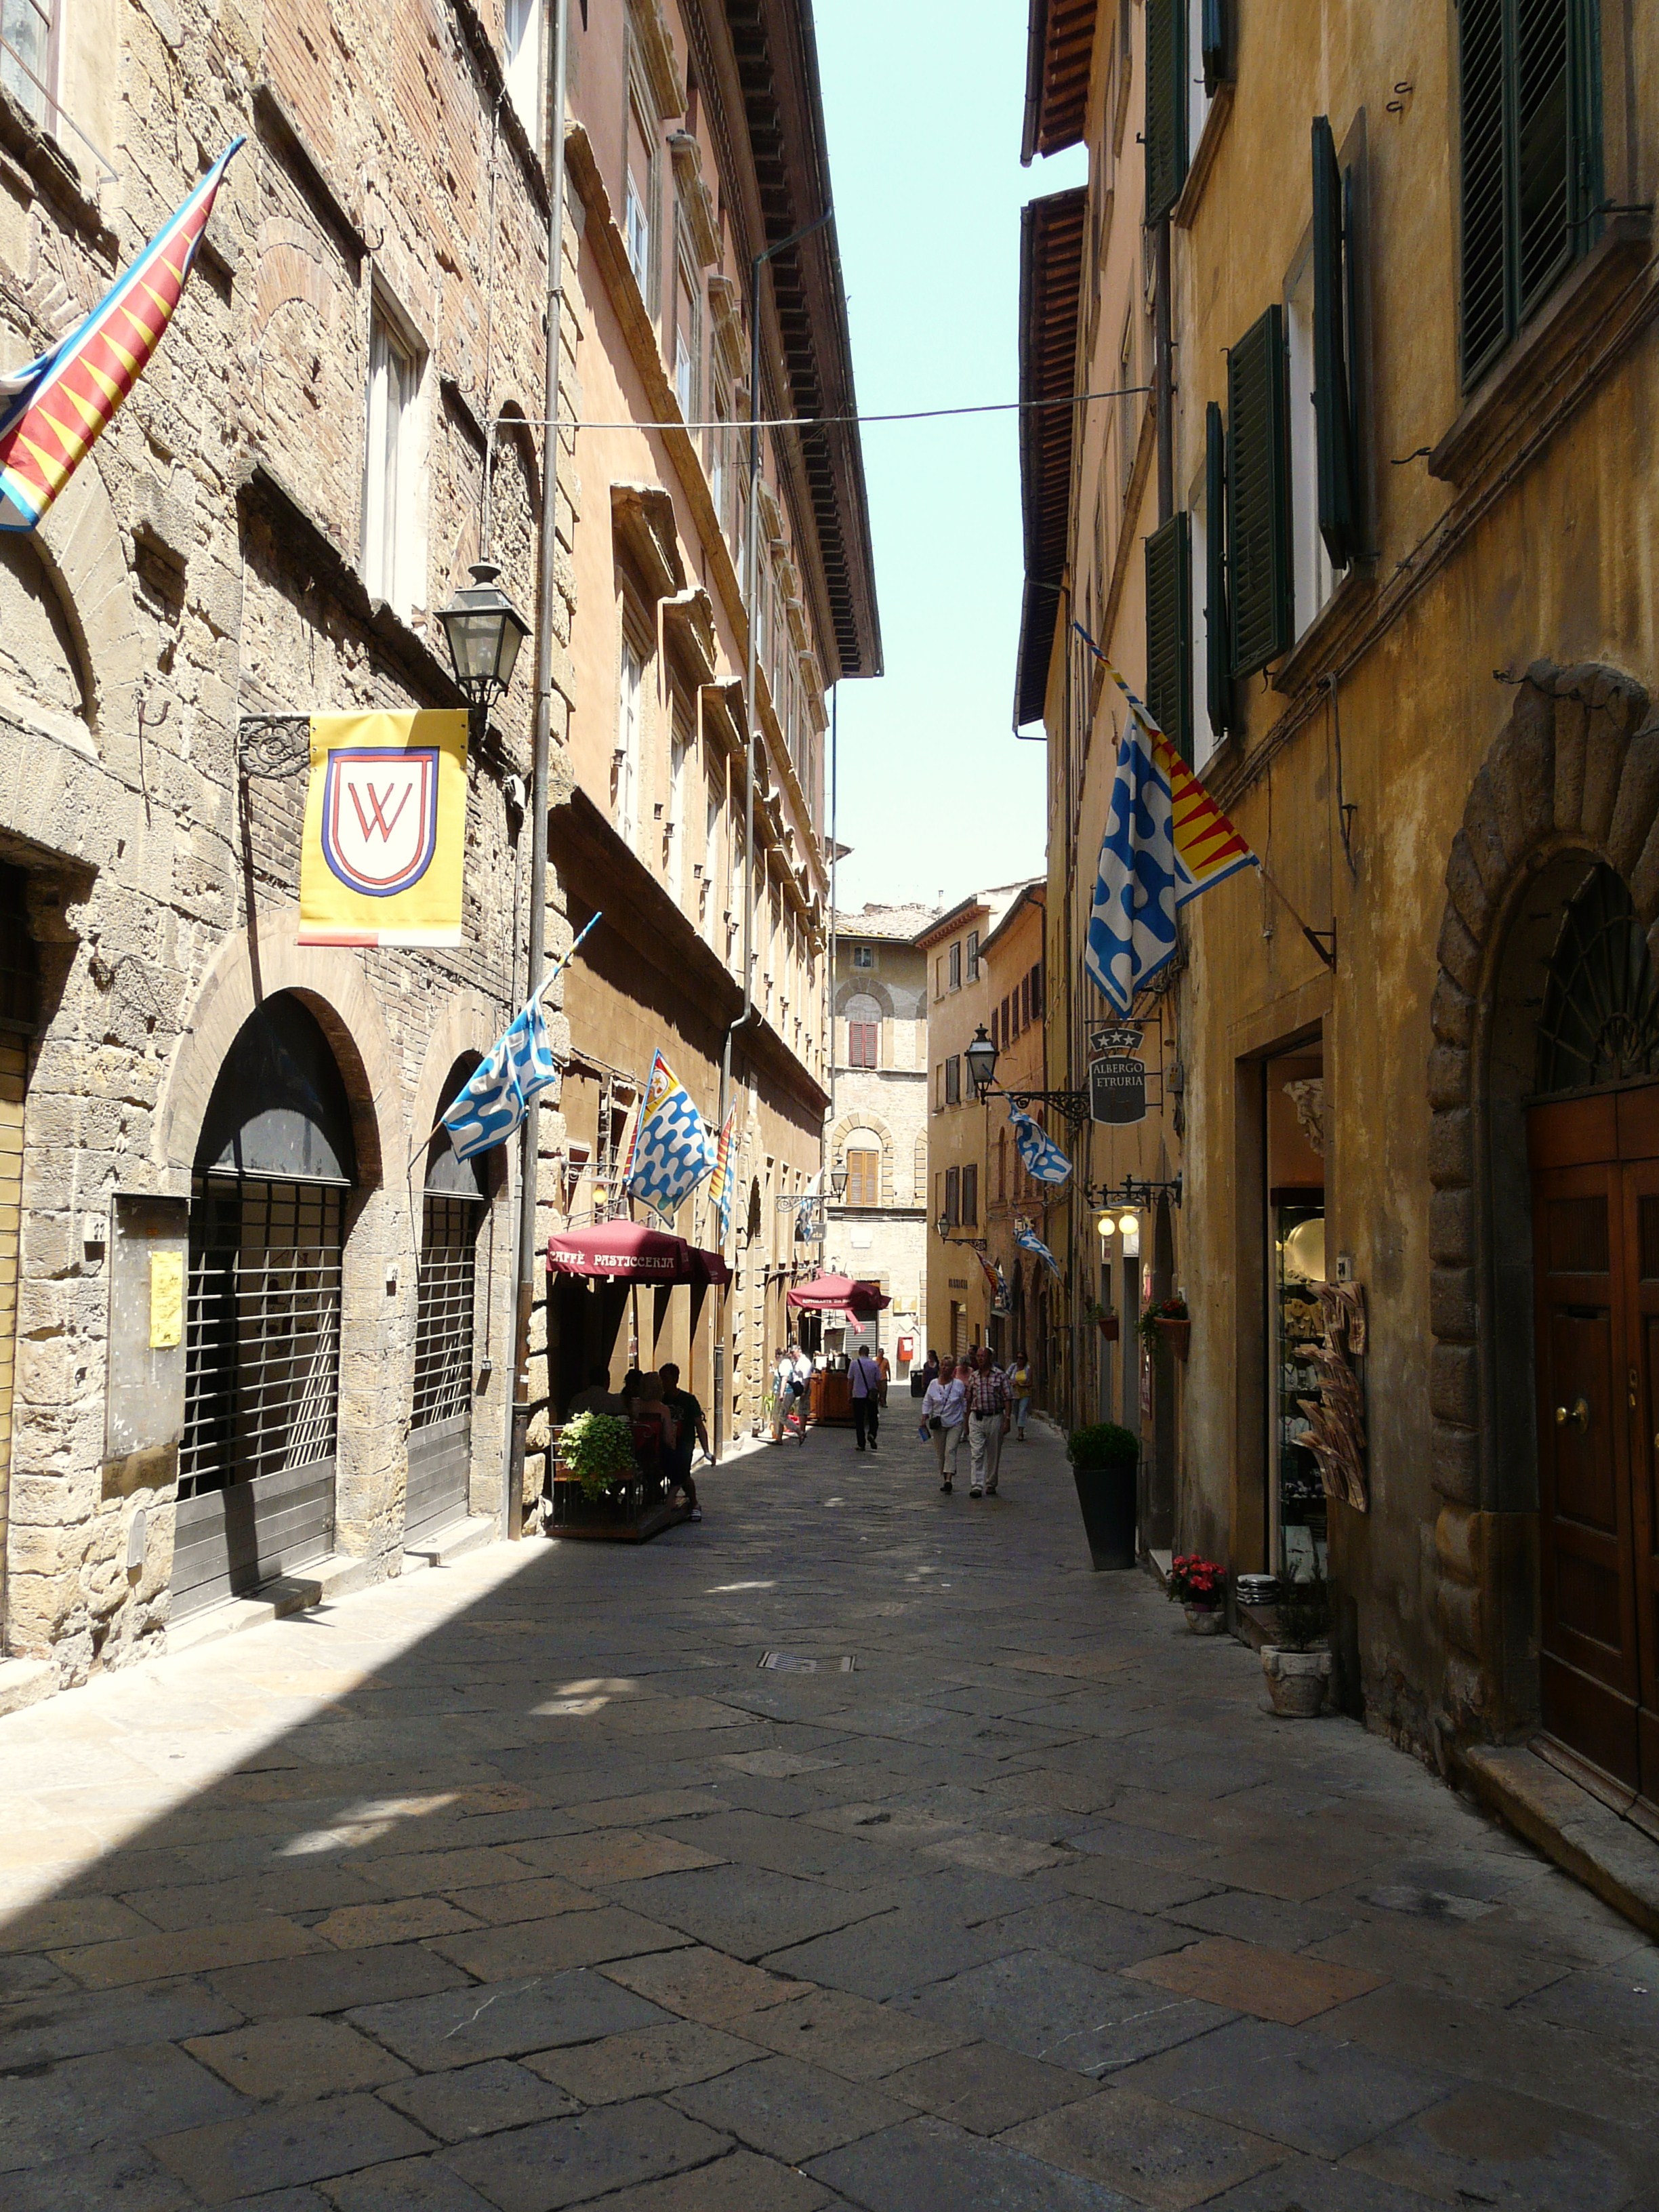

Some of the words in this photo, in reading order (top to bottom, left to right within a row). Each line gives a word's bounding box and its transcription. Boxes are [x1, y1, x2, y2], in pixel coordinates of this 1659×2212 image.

[1093, 1063, 1143, 1074] ALBERGO
[1097, 1077, 1143, 1087] ETRURIA
[550, 1250, 585, 1265] CAFFÈ
[594, 1254, 674, 1268] PASTICCERIA
